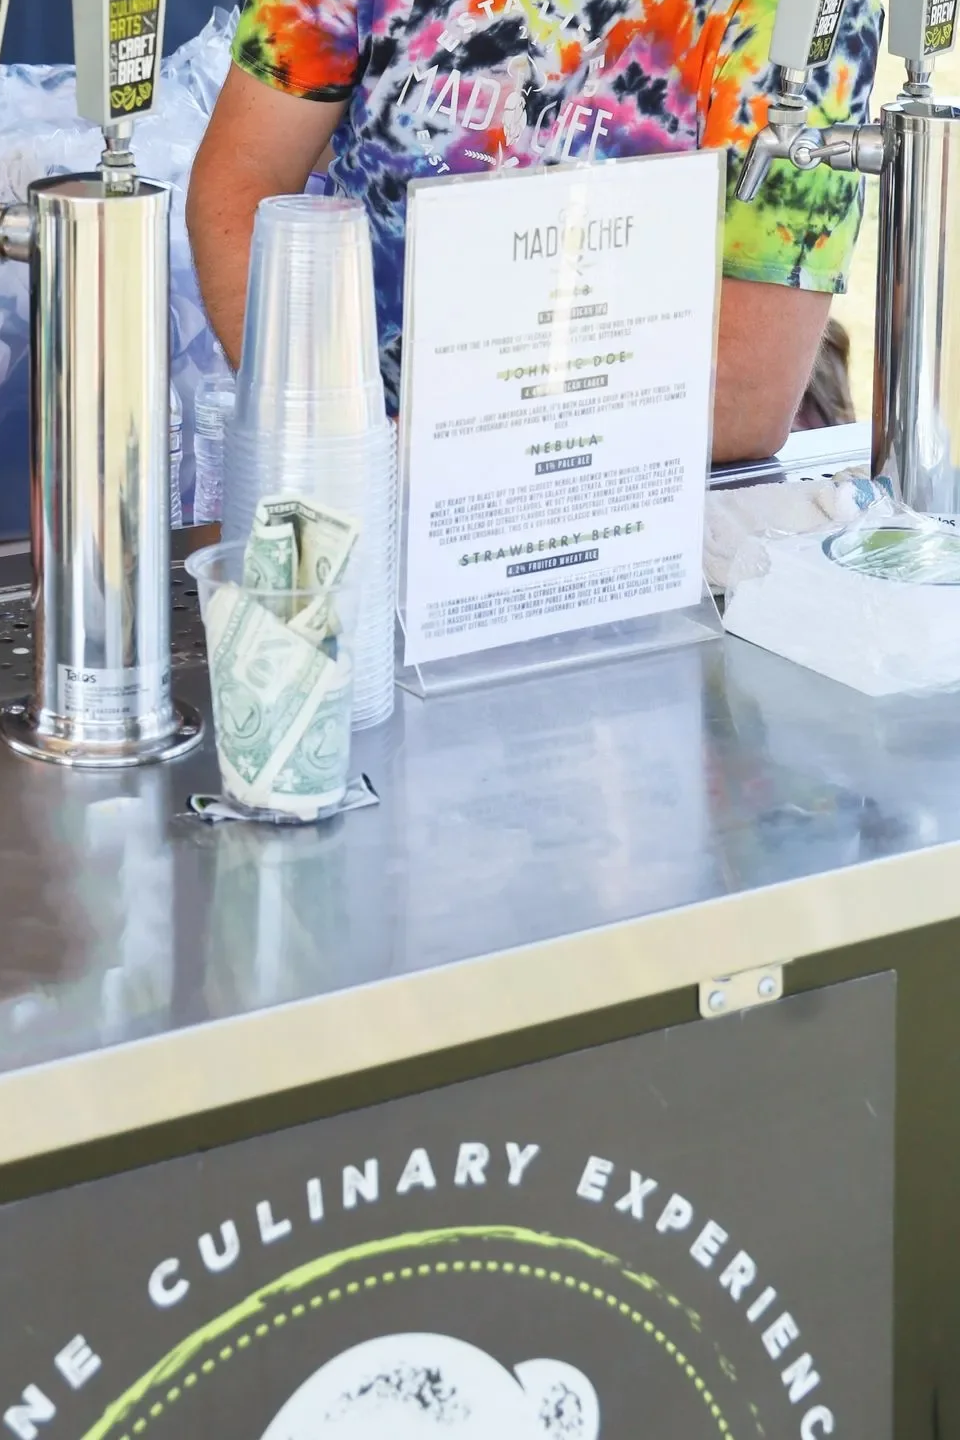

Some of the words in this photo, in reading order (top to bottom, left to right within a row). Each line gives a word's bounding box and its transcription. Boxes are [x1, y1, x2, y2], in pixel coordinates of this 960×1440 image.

[110, 14, 142, 41] ARTS
[930, 0, 956, 27] BREW
[118, 33, 156, 61] CRAFT
[118, 55, 155, 86] BREW
[396, 62, 502, 131] MAD
[513, 225, 559, 262] MAD
[587, 215, 635, 251] CHEF
[593, 351, 627, 368] DOE
[530, 434, 598, 456] NEBULA
[461, 532, 581, 567] STRAWBERRY
[591, 520, 643, 541] BERET
[528, 558, 557, 572] FRUITED
[559, 552, 583, 565] WHEAT
[585, 550, 597, 561] ALE
[146, 1141, 541, 1309] CULINARY
